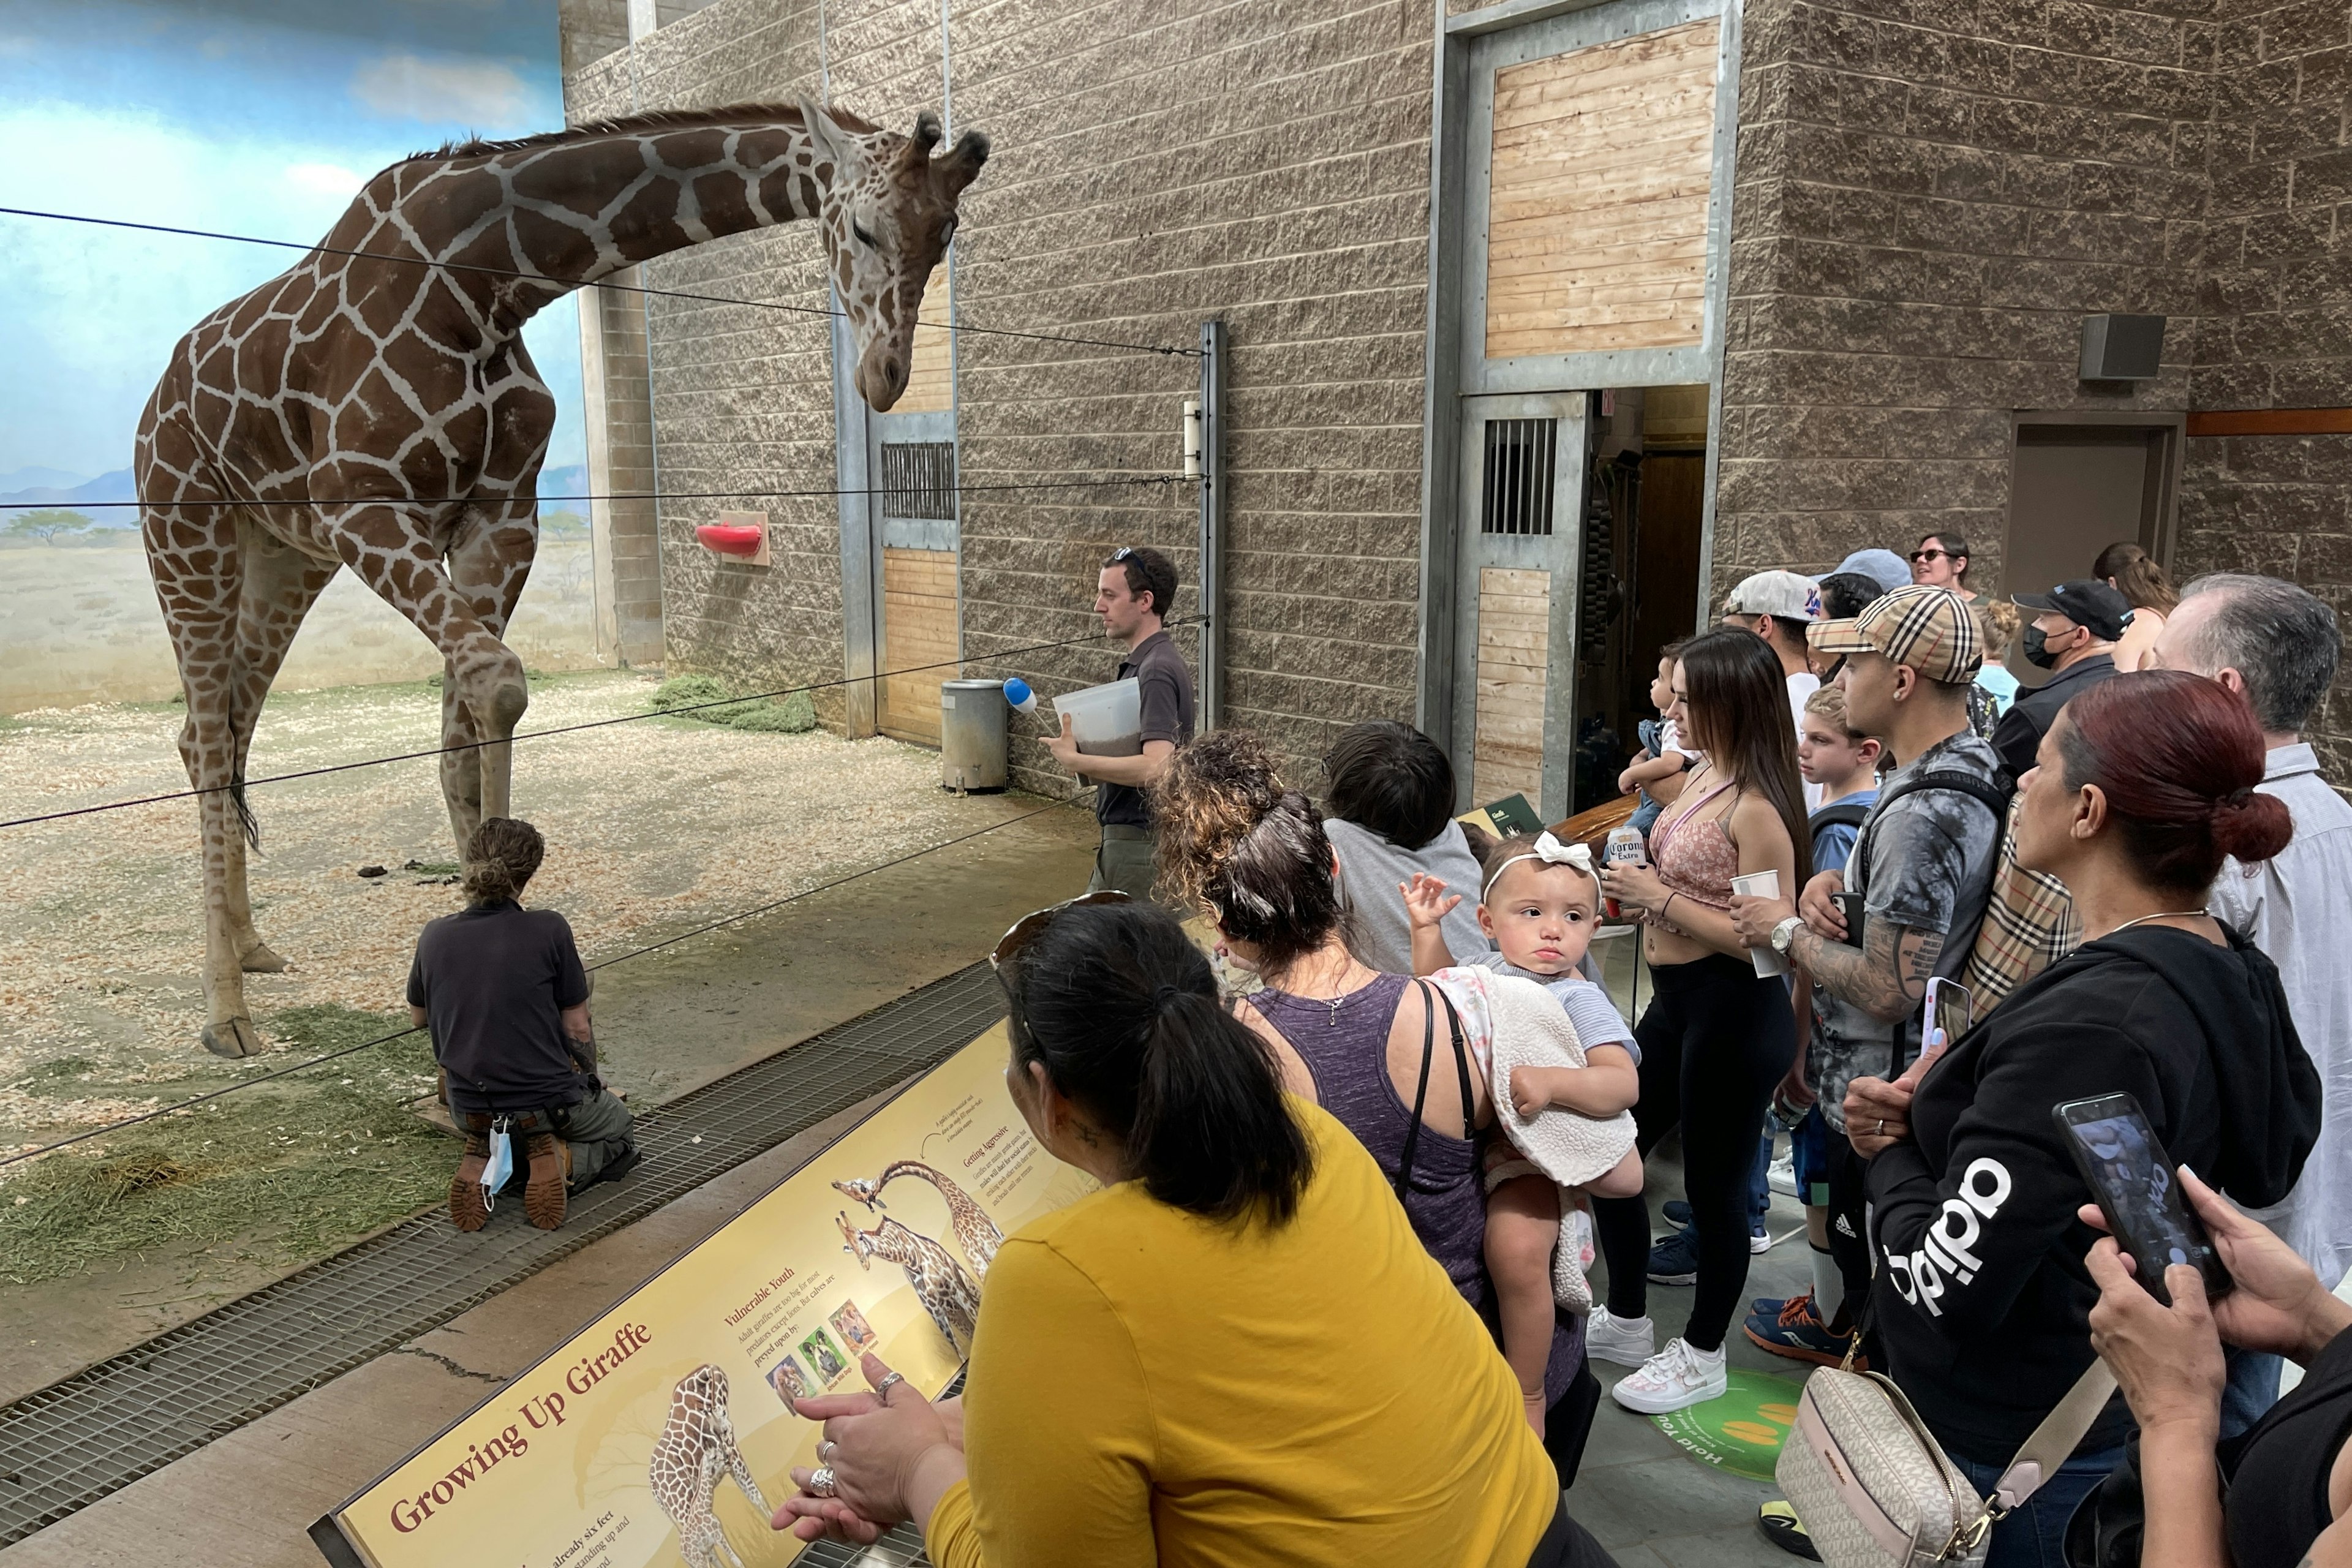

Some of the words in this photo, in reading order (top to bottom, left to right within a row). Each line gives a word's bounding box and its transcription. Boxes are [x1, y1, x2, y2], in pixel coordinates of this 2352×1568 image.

[1913, 773, 1989, 791] BURBERR
[963, 1148, 986, 1167] Getting
[982, 1126, 1009, 1150] Aggressive
[980, 1178, 991, 1189] males
[997, 1161, 1006, 1172] duel
[1010, 1147, 1021, 1159] social
[1020, 1140, 1030, 1151] status
[998, 1176, 1007, 1186] each
[1014, 1161, 1022, 1170] with
[1020, 1155, 1029, 1164] their
[724, 1287, 771, 1327] Vulnerable
[769, 1267, 795, 1291] Youth
[739, 1327, 754, 1344] Adult
[753, 1311, 774, 1332] giraffes
[773, 1304, 782, 1314] are
[781, 1296, 791, 1306] too
[790, 1288, 801, 1298] big
[798, 1283, 808, 1291] for
[807, 1270, 820, 1284] most
[746, 1332, 772, 1357] predators
[771, 1316, 789, 1333] except
[800, 1296, 811, 1307] But
[810, 1281, 826, 1298] calves
[826, 1274, 835, 1285] are
[755, 1344, 775, 1368] preyed
[774, 1332, 790, 1348] upon
[788, 1323, 799, 1333] by:
[827, 1380, 839, 1393] African
[843, 1367, 852, 1376] Dogs
[391, 1424, 528, 1533] Growing
[518, 1392, 566, 1429] Up
[567, 1323, 652, 1395] Giraffe
[1657, 1414, 1679, 1437] You
[1676, 1438, 1723, 1464] Hold
[552, 1538, 584, 1568] already
[584, 1526, 598, 1540] six
[597, 1510, 614, 1528] feet
[574, 1541, 607, 1568] standing
[605, 1531, 616, 1543] up
[616, 1516, 630, 1533] and
